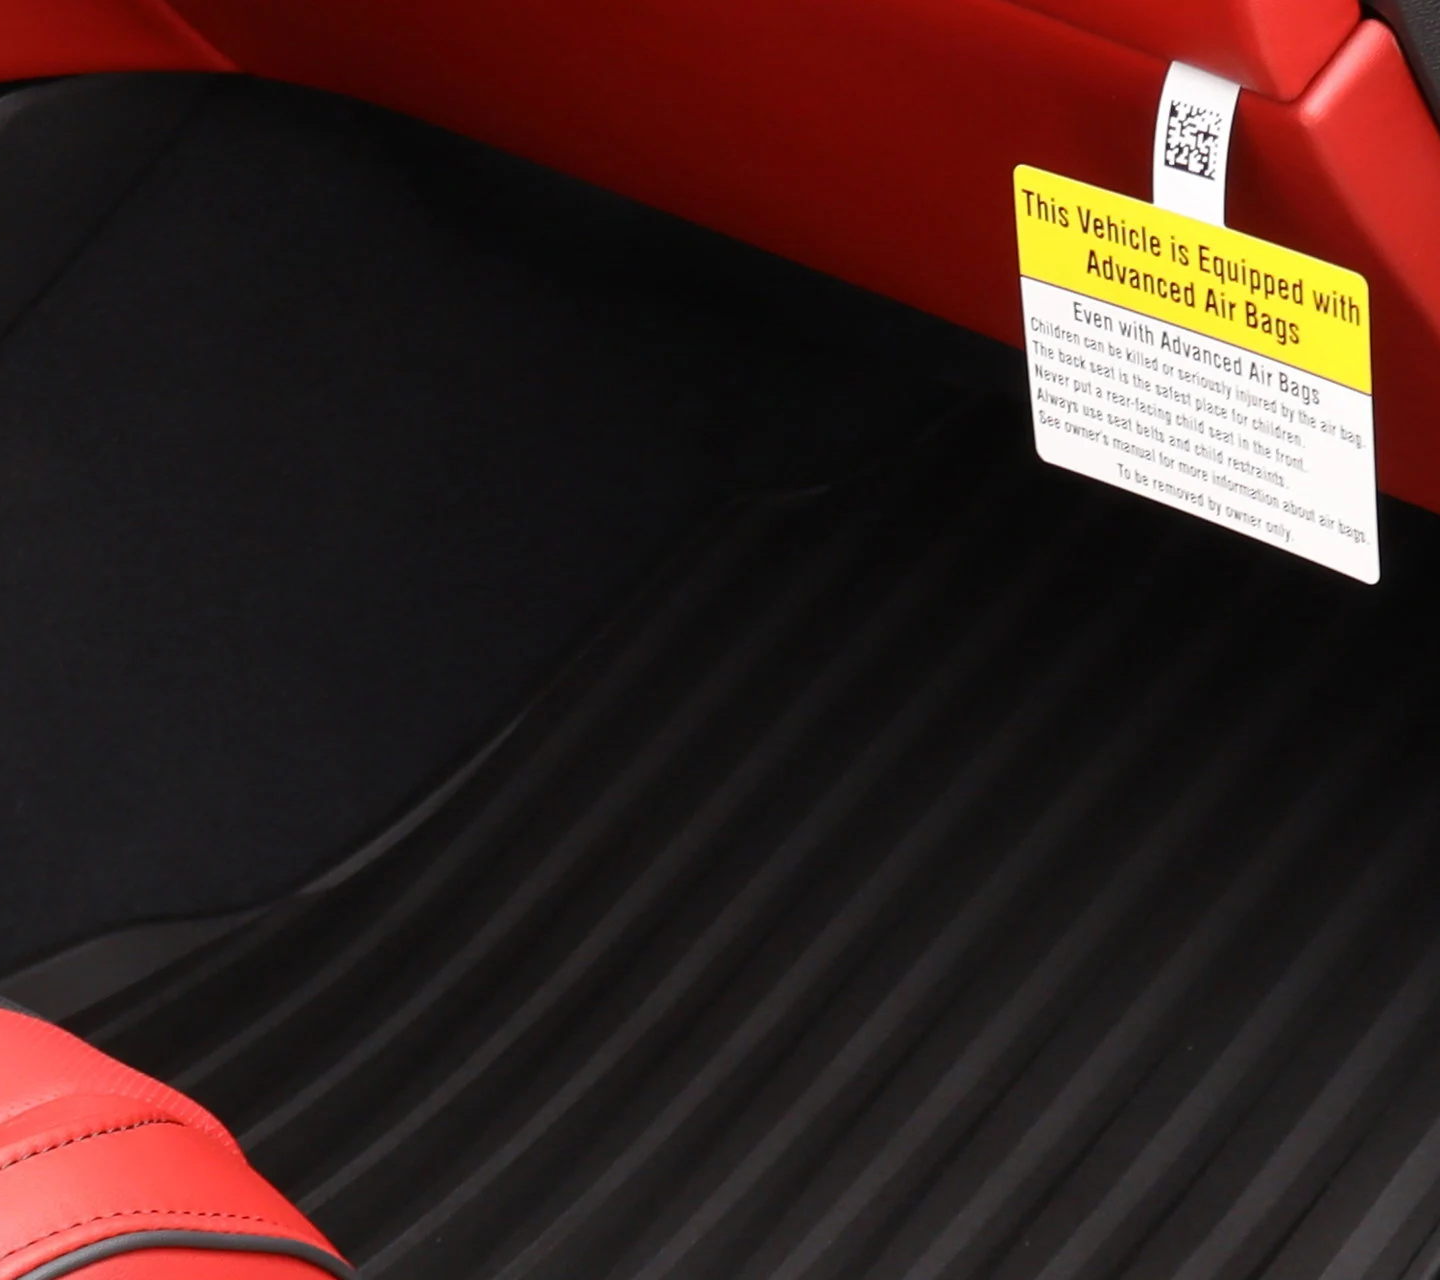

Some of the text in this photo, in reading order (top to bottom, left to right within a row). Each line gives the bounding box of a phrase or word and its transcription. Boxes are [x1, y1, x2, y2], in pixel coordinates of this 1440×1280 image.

[1021, 188, 1360, 326] This Vehicle is Equipped with
[1086, 249, 1300, 346] Advanced Air Bags
[1072, 301, 1320, 406] Even with Advanced Air Bags
